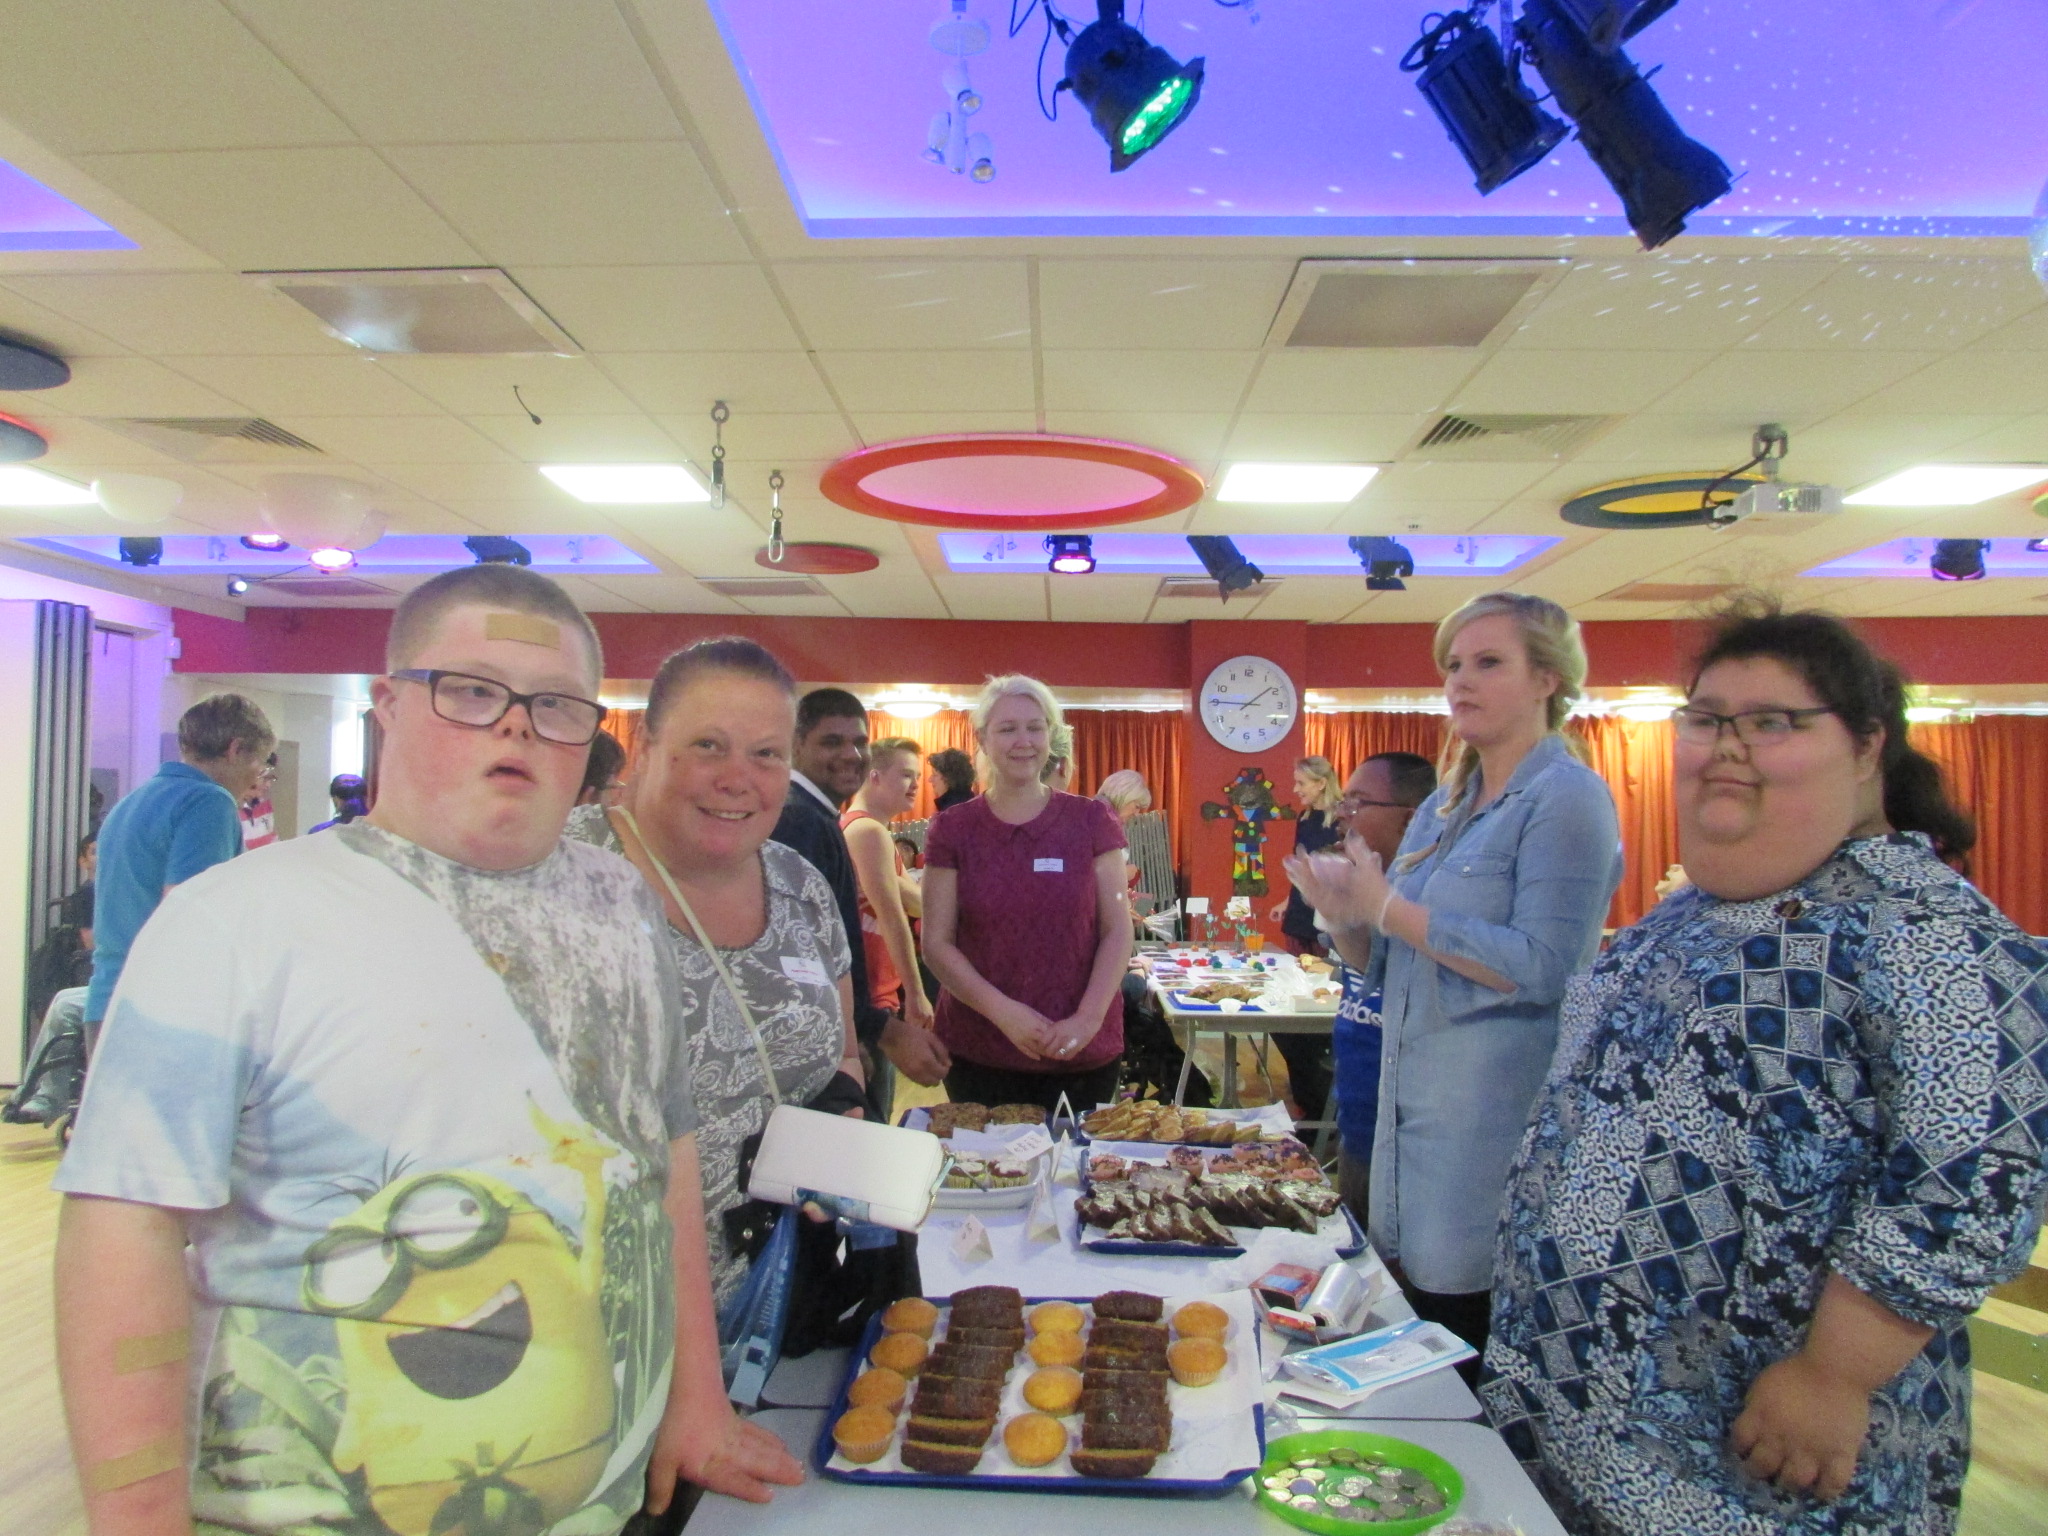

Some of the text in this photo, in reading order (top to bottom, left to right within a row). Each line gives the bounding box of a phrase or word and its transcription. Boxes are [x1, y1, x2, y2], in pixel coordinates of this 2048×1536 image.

[1230, 673, 1236, 681] 11
[1244, 669, 1254, 677] 12
[1217, 685, 1228, 693] 10
[1271, 688, 1279, 696] 2
[1212, 698, 1220, 706] 9
[1276, 701, 1284, 710] 3
[1270, 718, 1278, 726] 4
[1228, 727, 1236, 735] 7
[1258, 728, 1266, 737] 5
[1243, 732, 1250, 740] 6
